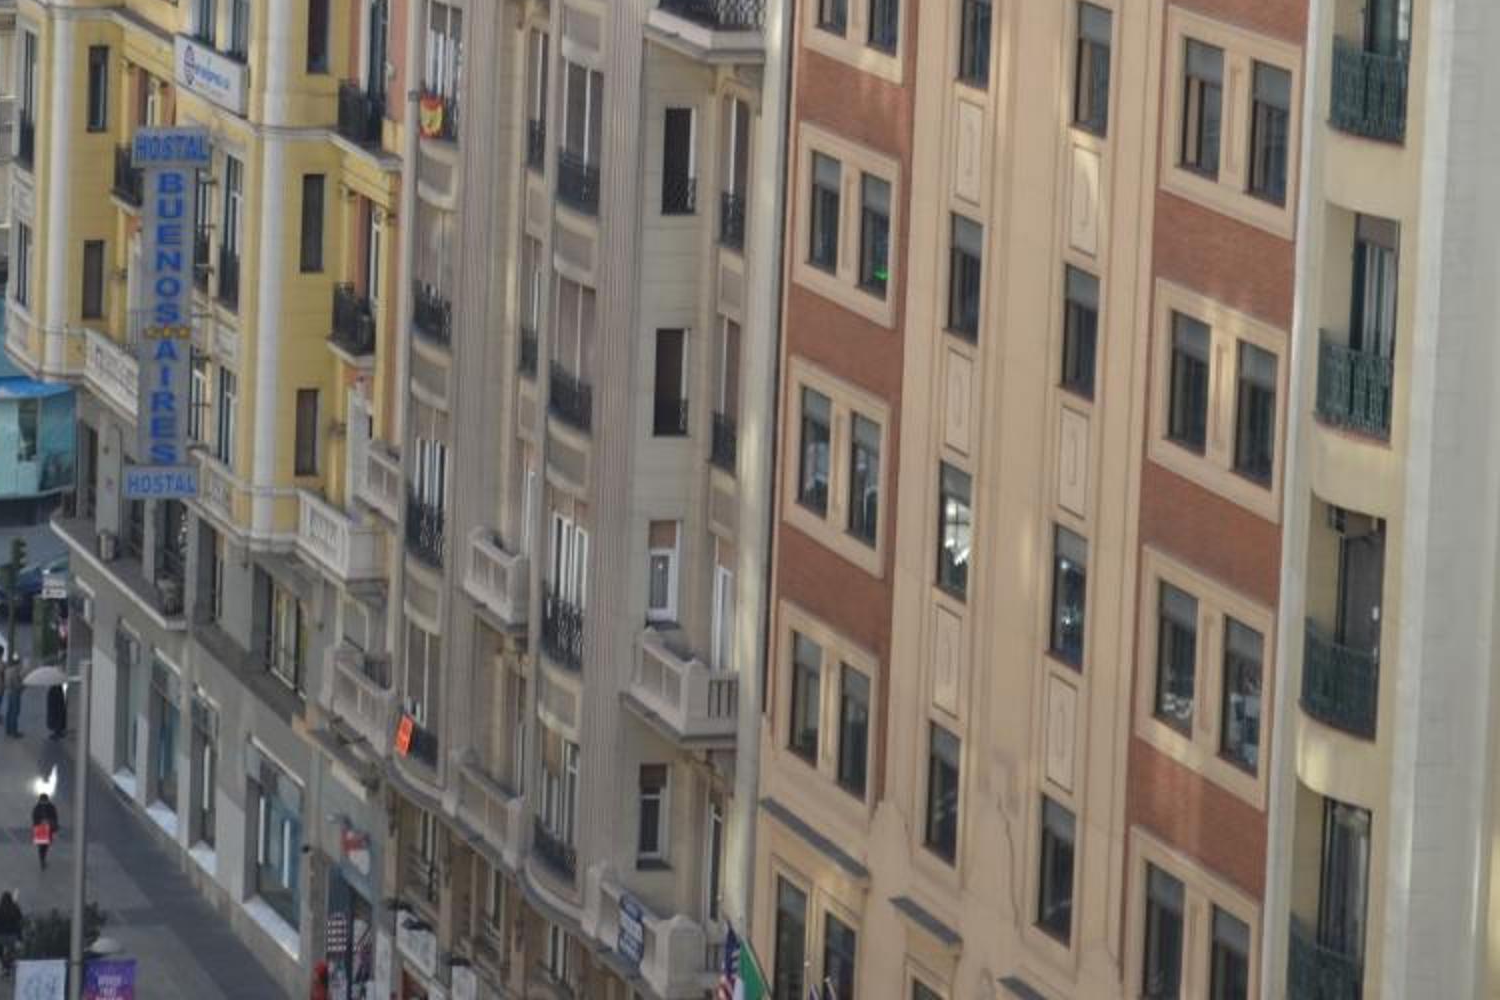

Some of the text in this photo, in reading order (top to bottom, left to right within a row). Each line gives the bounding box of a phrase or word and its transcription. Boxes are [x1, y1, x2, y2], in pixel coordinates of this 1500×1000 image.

[135, 134, 209, 161] HOSTAL
[151, 173, 184, 465] BUENOS AIRES
[128, 471, 197, 493] HOSTAL
